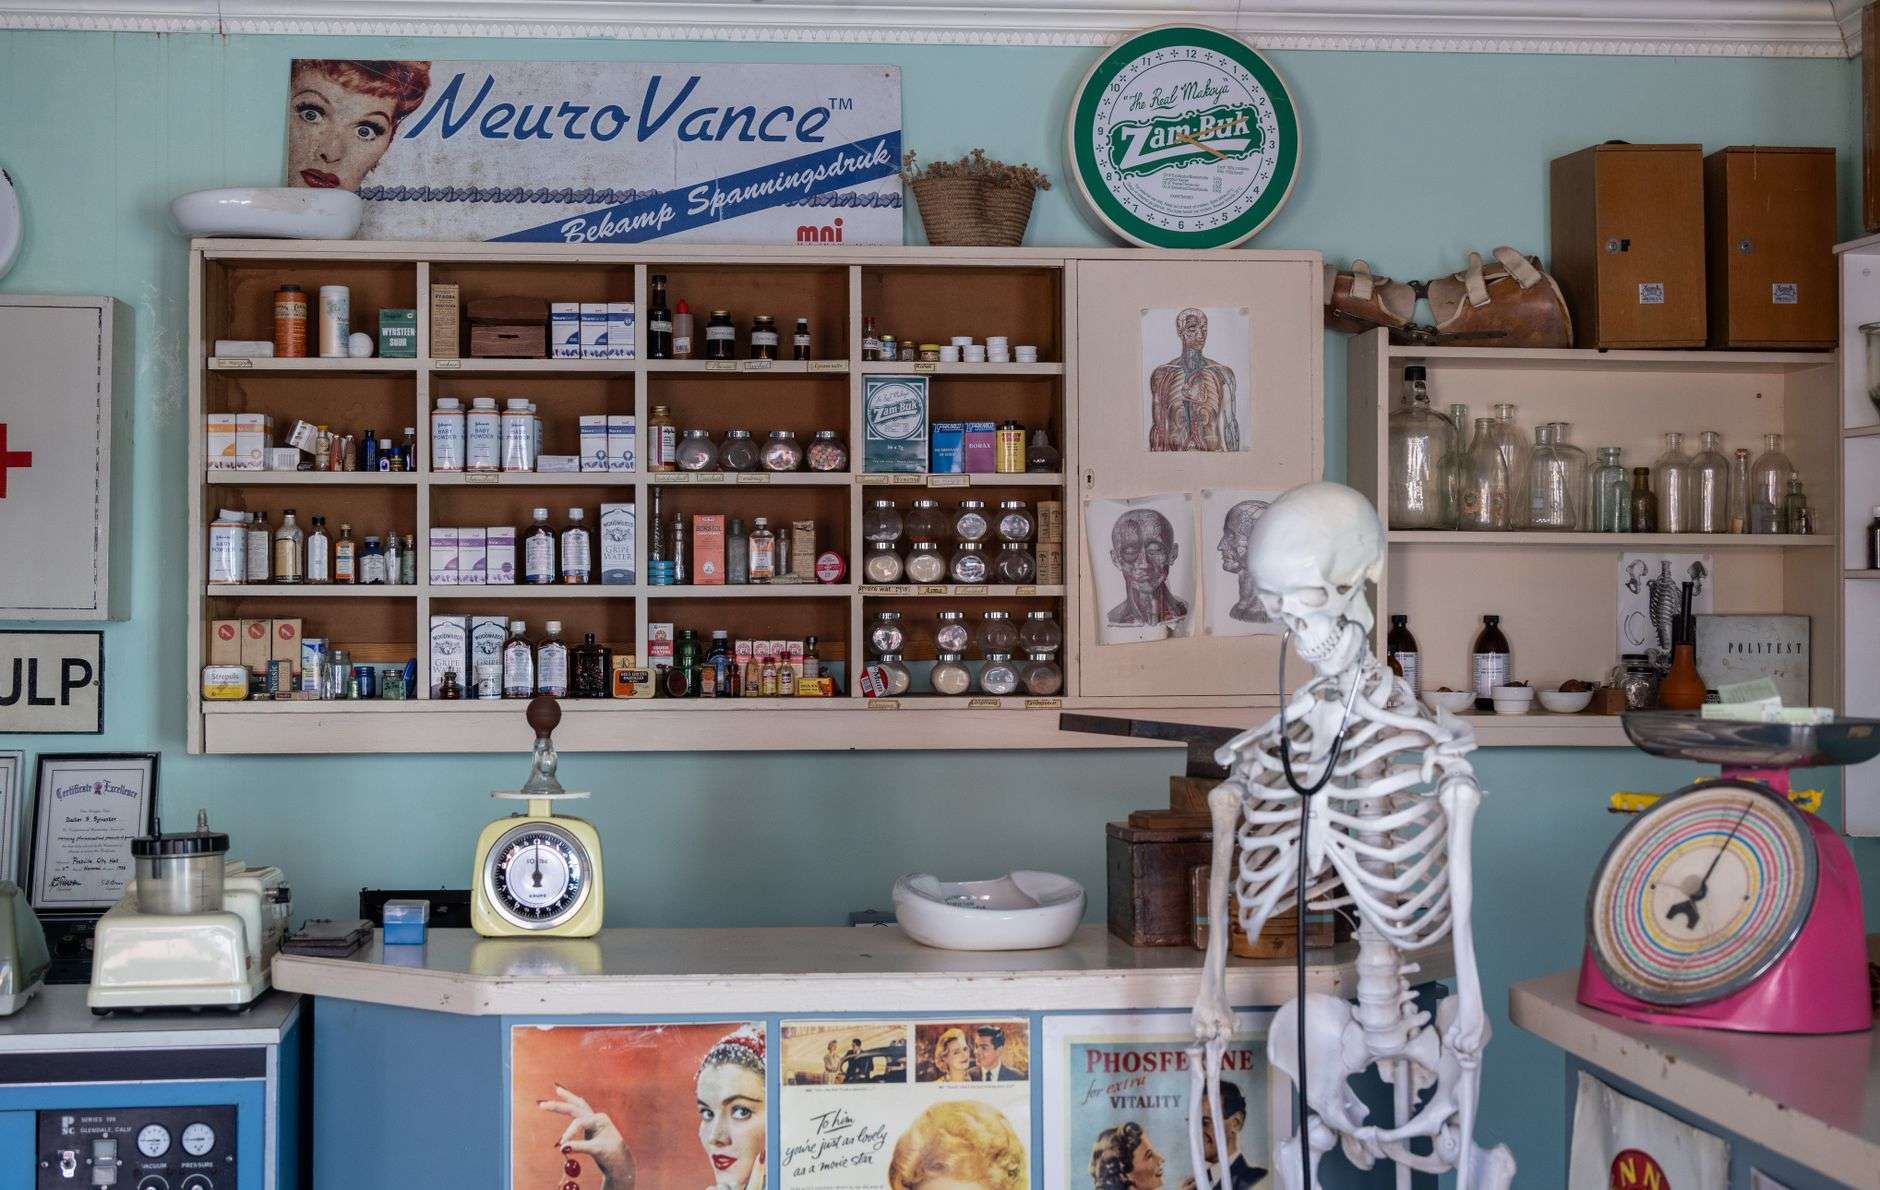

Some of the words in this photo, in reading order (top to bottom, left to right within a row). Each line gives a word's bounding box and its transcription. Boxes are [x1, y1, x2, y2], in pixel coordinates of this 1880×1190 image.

[1185, 49, 1197, 58] 12
[1142, 57, 1151, 66] 11
[1110, 83, 1120, 92] 10
[1259, 97, 1266, 106] 2
[403, 72, 829, 143] NeuroVance
[1097, 126, 1104, 136] 9
[1269, 140, 1275, 149] 3
[1106, 172, 1112, 181] 8
[561, 204, 676, 244] Bekamp
[687, 138, 891, 223] Spanningsdruk
[1253, 186, 1259, 195] 4
[1133, 204, 1139, 213] 7
[1222, 212, 1228, 221] 5
[1178, 220, 1184, 229] 6
[796, 217, 844, 243] mni
[1728, 642, 1803, 655] POLYTEST
[56, 783, 92, 800] Certificate
[103, 779, 138, 799] Excellence
[1086, 1049, 1254, 1073] PHOSFENE
[1106, 1075, 1146, 1095] extra
[1110, 1095, 1182, 1110] VITALITY
[810, 1110, 834, 1135] To
[834, 1108, 855, 1127] him
[812, 1134, 840, 1160] just
[841, 1136, 855, 1147] as
[857, 1124, 888, 1151] lovely
[141, 1162, 168, 1170] VACUUM
[181, 1161, 214, 1169] PRESSURE
[793, 1165, 807, 1178] as
[808, 1164, 816, 1174] a
[820, 1155, 849, 1171] movie
[850, 1152, 874, 1166] star
